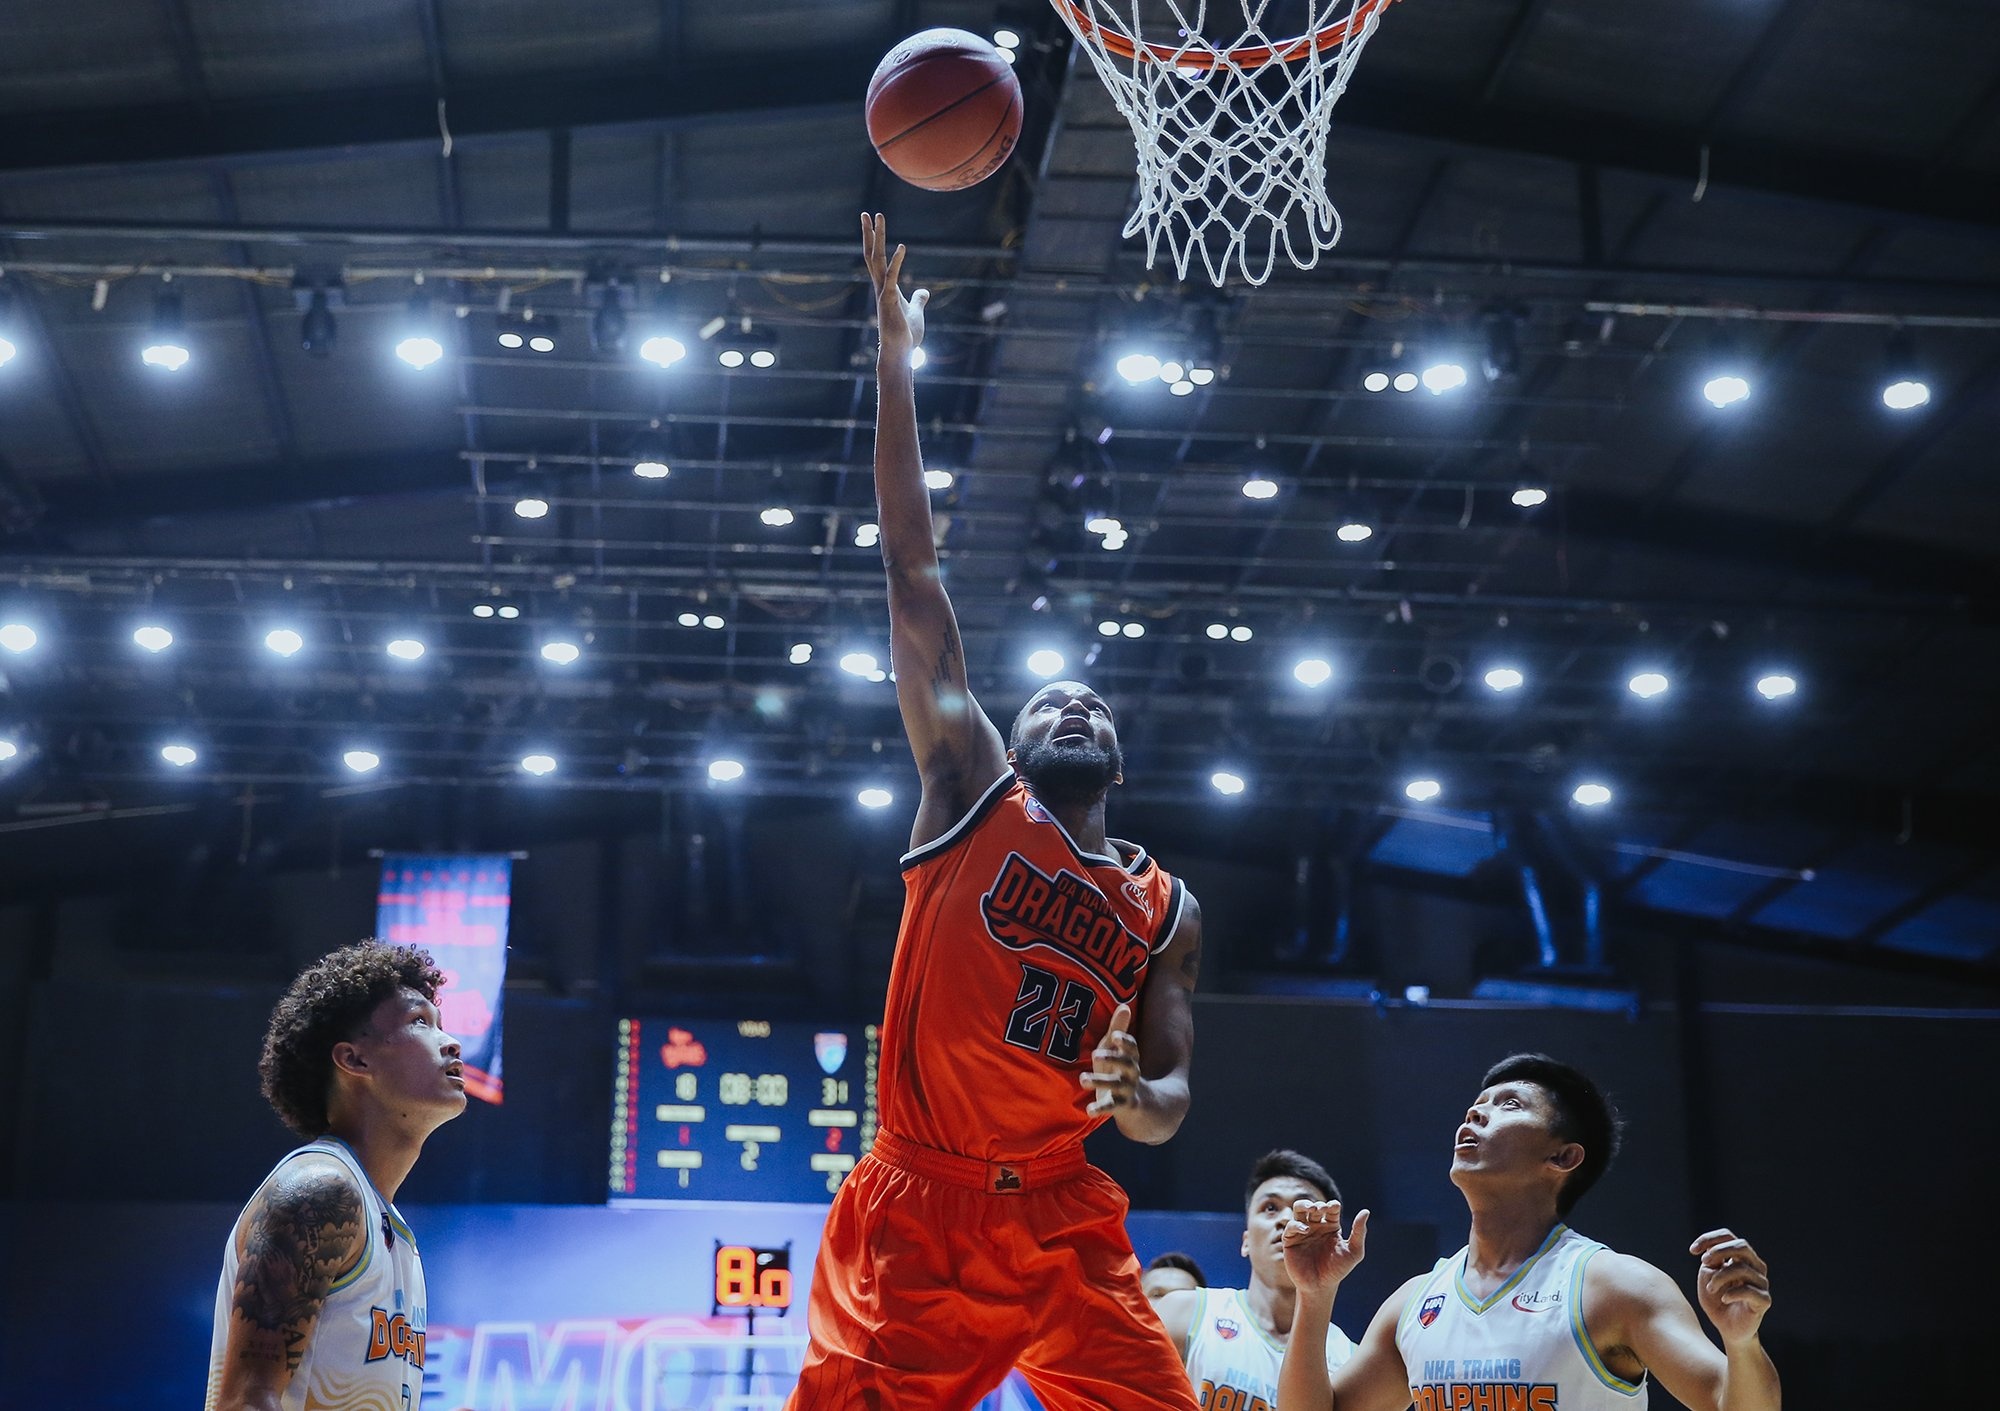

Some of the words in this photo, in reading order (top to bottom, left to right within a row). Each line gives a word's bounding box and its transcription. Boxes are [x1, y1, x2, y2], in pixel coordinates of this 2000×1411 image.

[1057, 878, 1078, 898] DA
[1004, 963, 1096, 1063] 23
[716, 1246, 793, 1308] 8.0
[1226, 1367, 1260, 1393] NHA
[1424, 1360, 1455, 1380] NHA
[1462, 1358, 1521, 1380] TRANG
